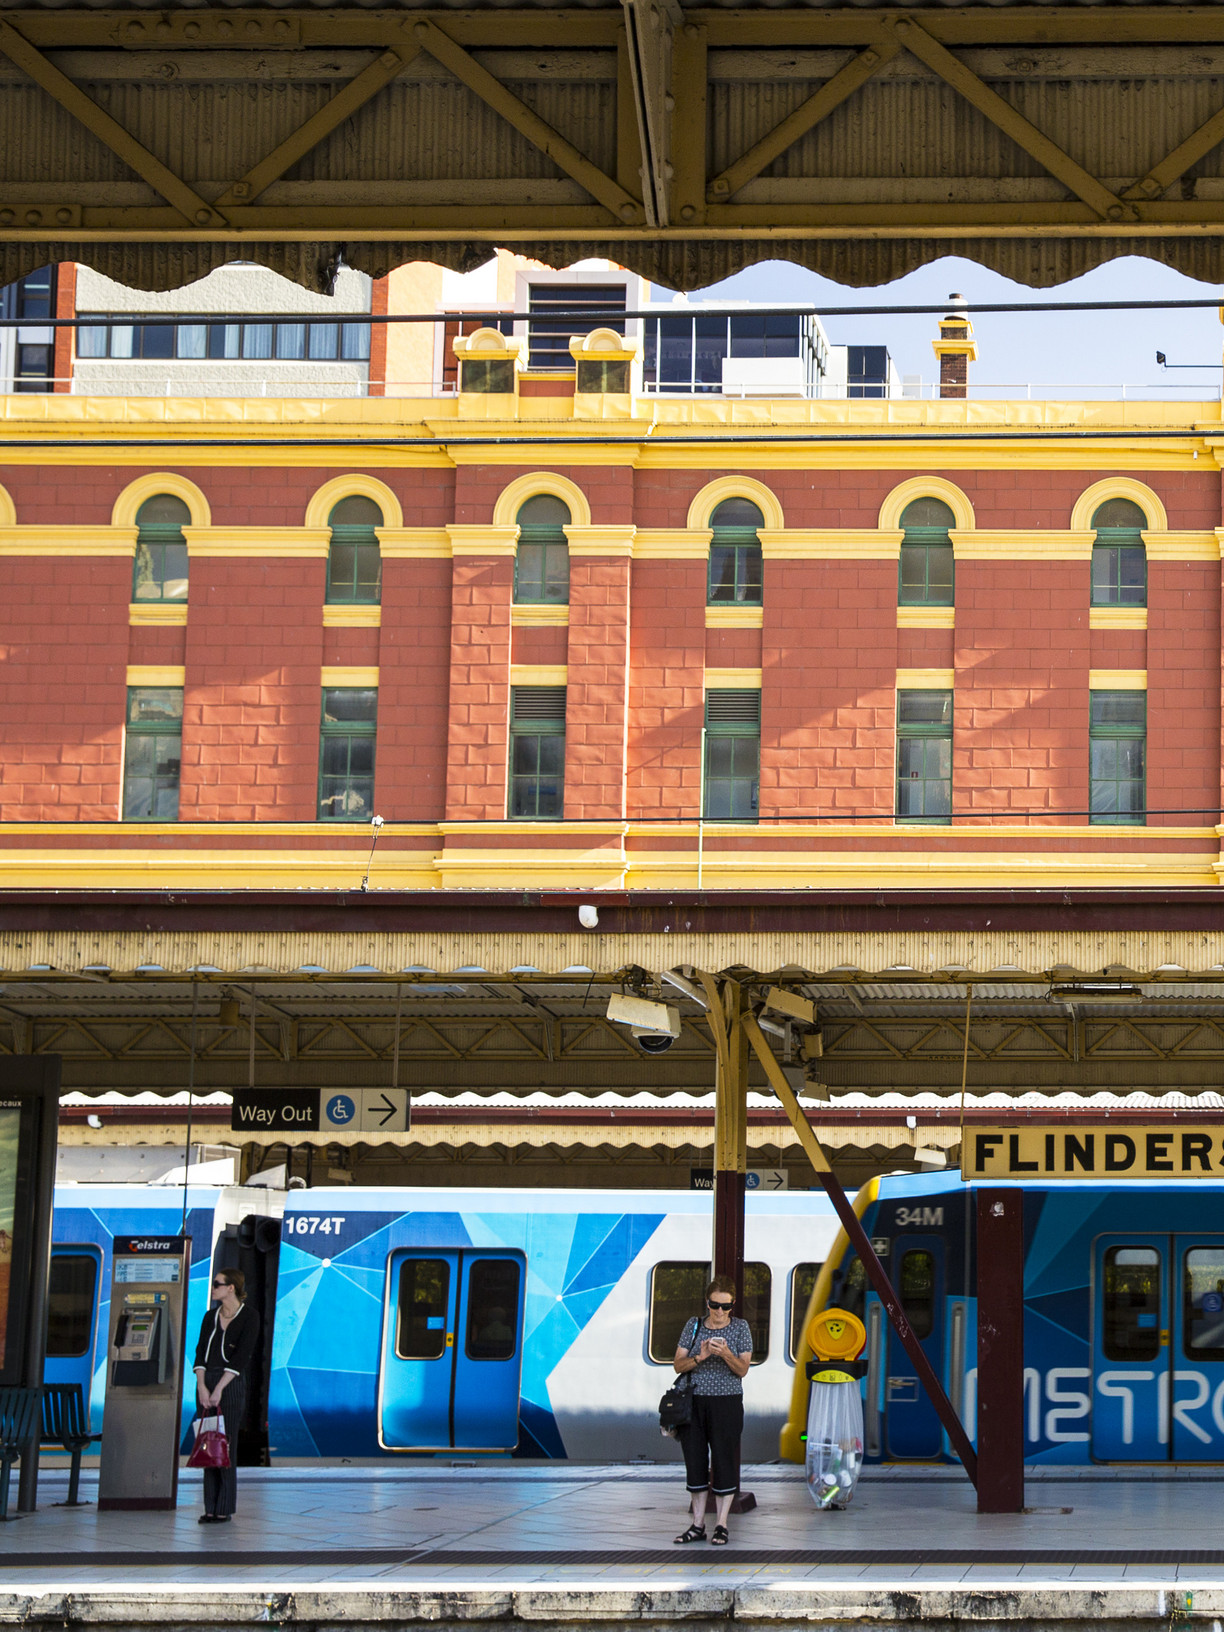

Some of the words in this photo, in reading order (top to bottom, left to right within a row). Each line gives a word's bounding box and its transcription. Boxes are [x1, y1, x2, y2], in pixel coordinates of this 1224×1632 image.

[239, 1105, 276, 1125] Way
[281, 1105, 312, 1122] Out
[285, 1216, 346, 1235] 1674T
[895, 1207, 944, 1226] 34M
[128, 1240, 170, 1252] Telstra
